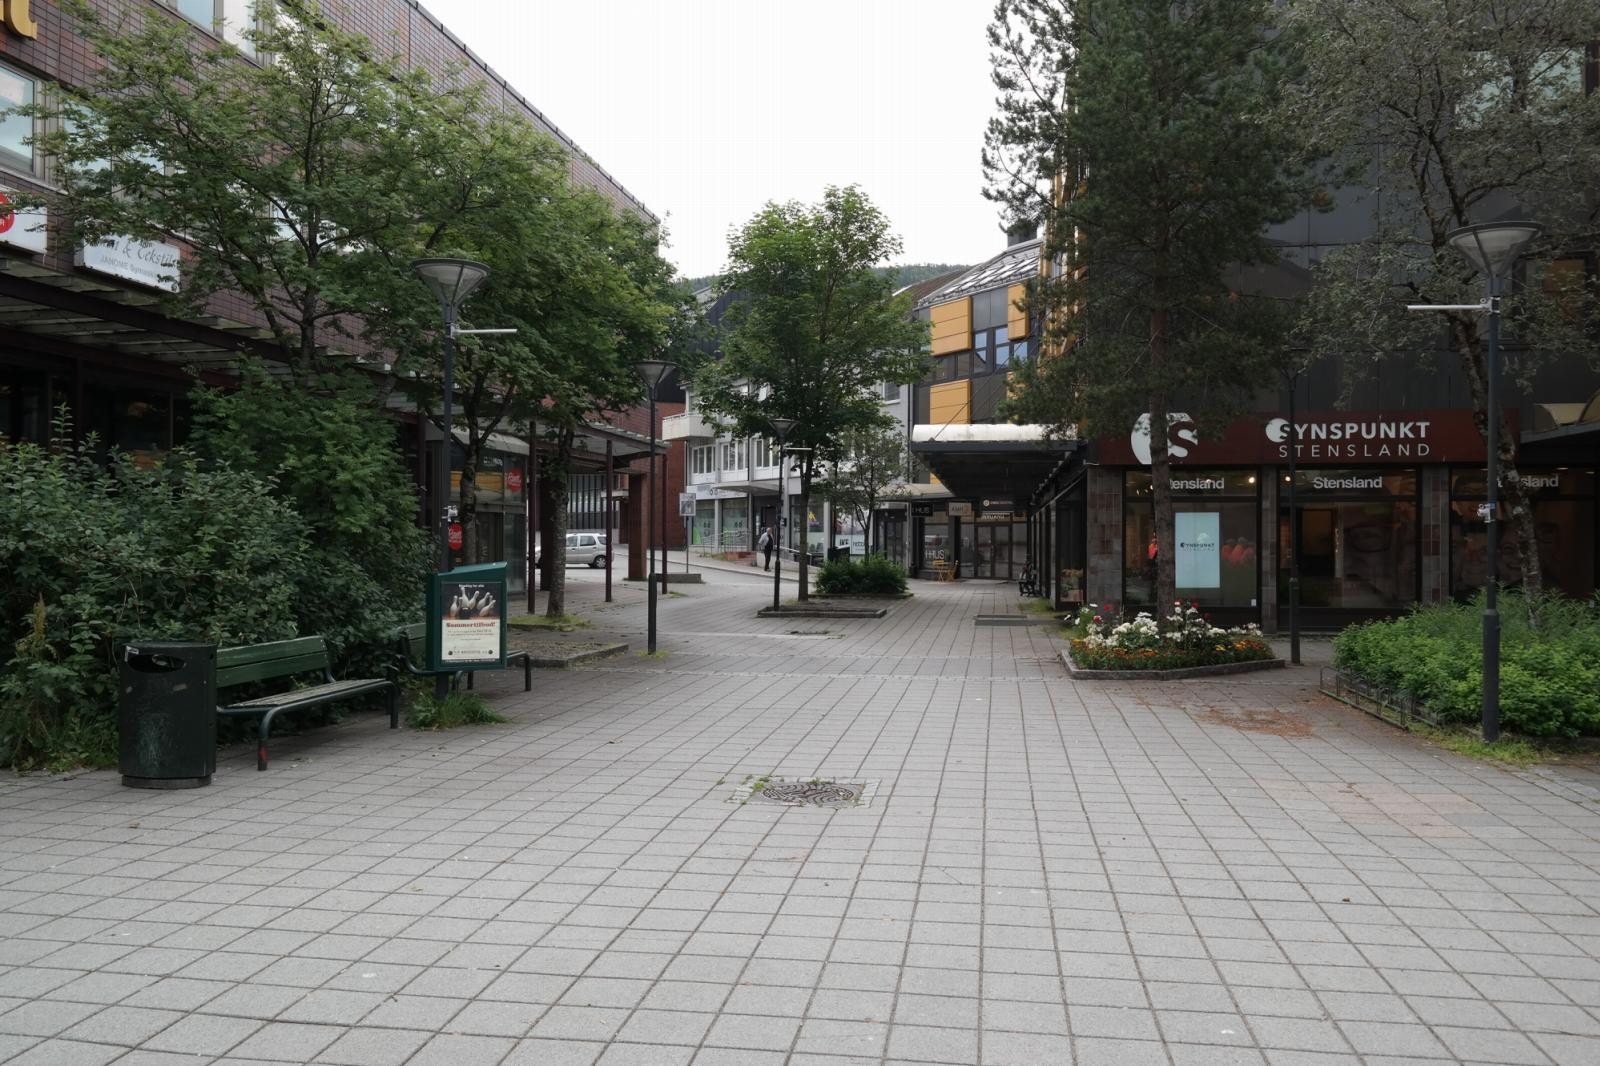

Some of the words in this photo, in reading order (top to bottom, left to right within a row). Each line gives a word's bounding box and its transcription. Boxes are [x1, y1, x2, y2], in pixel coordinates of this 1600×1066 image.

[1279, 421, 1430, 441] SYNSPUNKT
[1279, 444, 1430, 458] STENSLAND
[1169, 478, 1225, 490] tensland
[1313, 476, 1382, 489] Stensland
